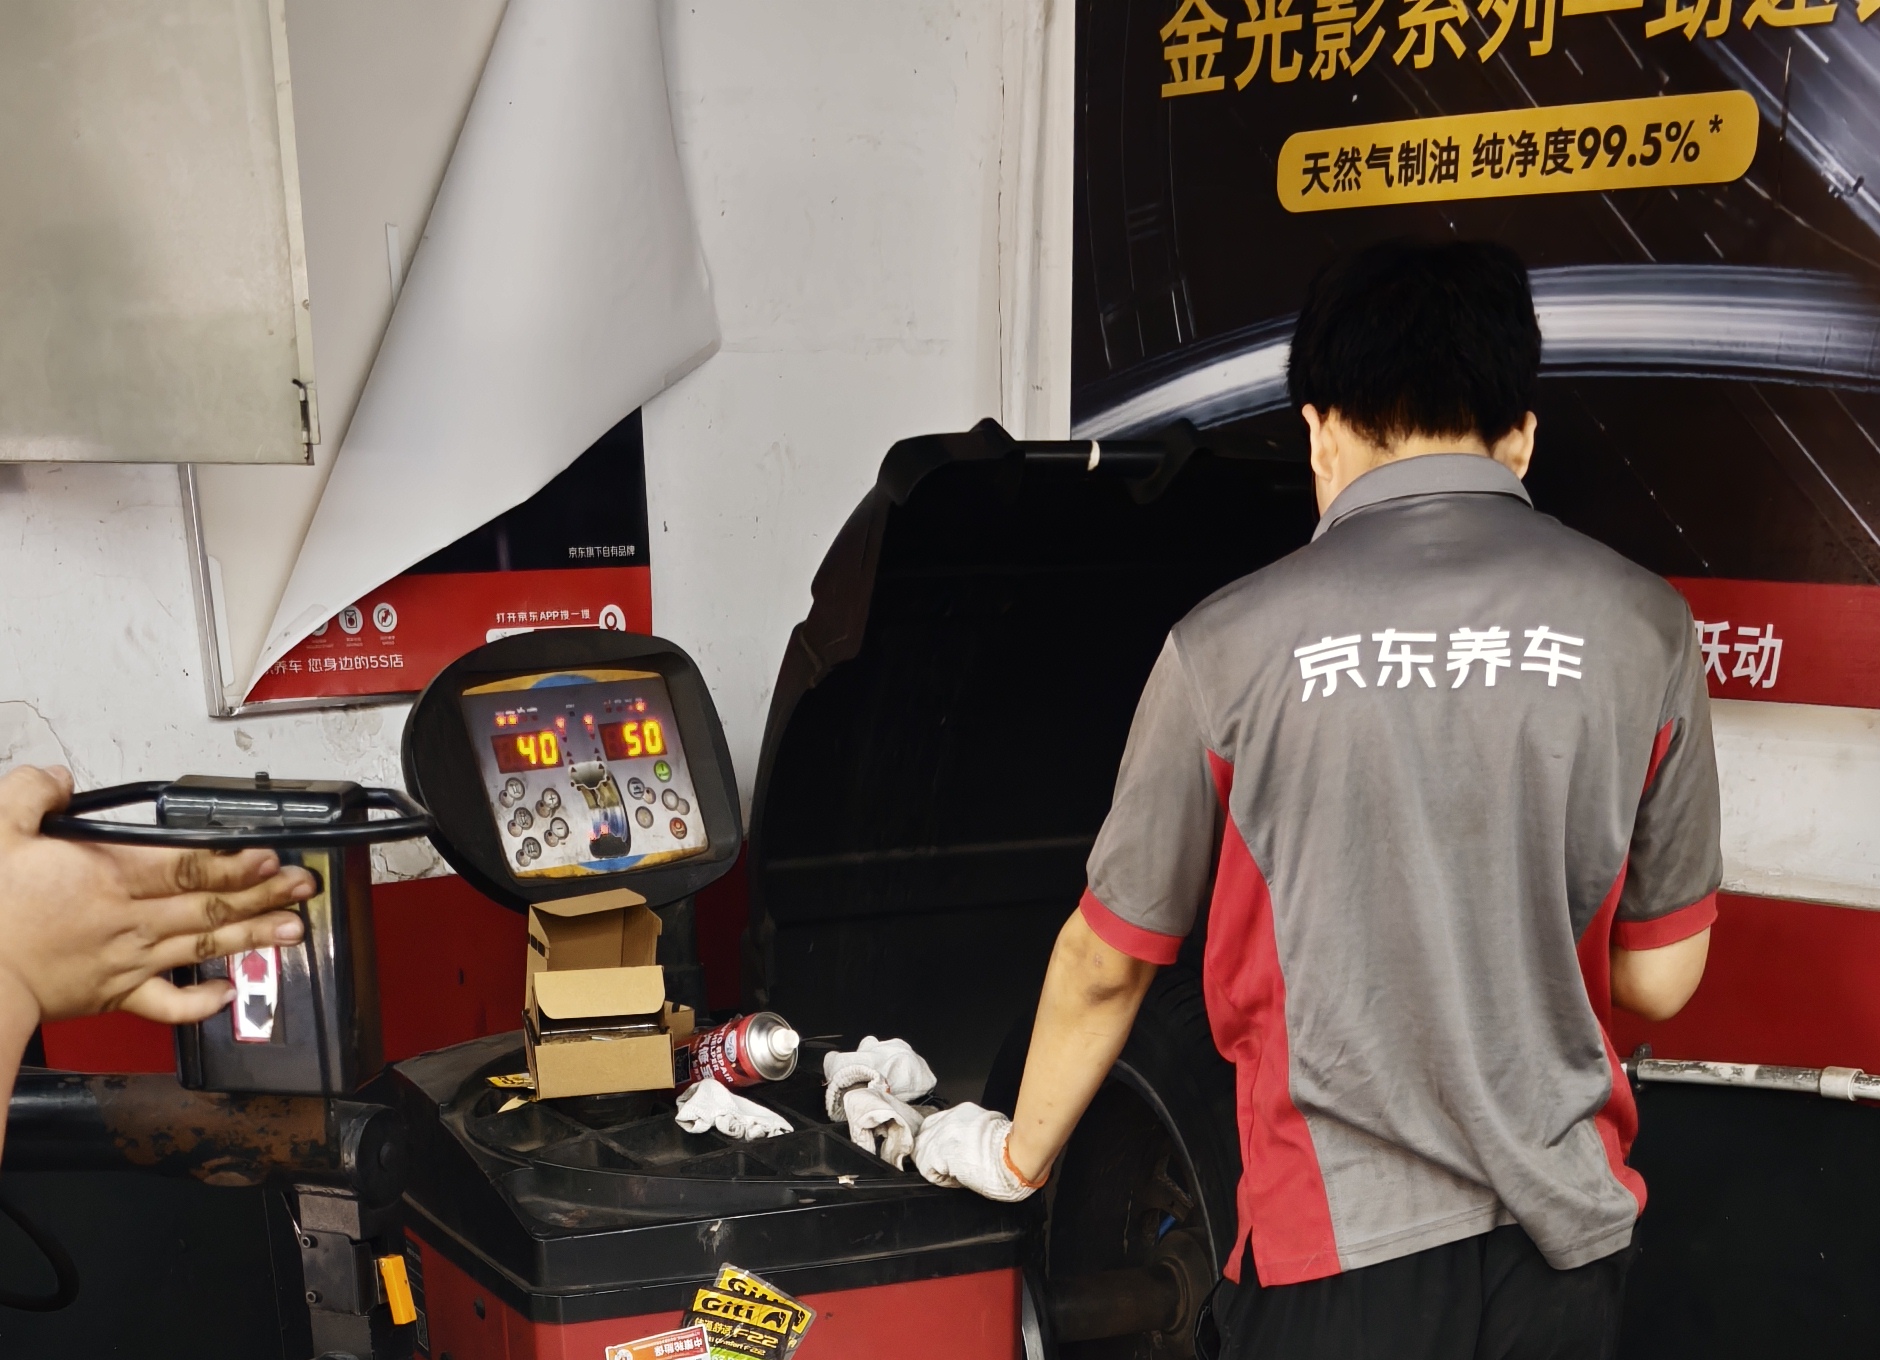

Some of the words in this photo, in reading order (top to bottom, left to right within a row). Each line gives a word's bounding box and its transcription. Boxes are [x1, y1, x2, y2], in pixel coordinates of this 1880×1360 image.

[1301, 136, 1461, 196] 天然气制油
[568, 545, 636, 558] 京东旗下自有品牌
[496, 608, 590, 624] 打开京东APP搜一搜
[266, 659, 303, 676] 养车
[308, 653, 405, 674] 您身边的5S店
[1294, 626, 1584, 702] 京东养车
[516, 730, 559, 766] 40
[622, 718, 663, 757] 50
[701, 1296, 757, 1320] Giti
[733, 1327, 779, 1349] F22
